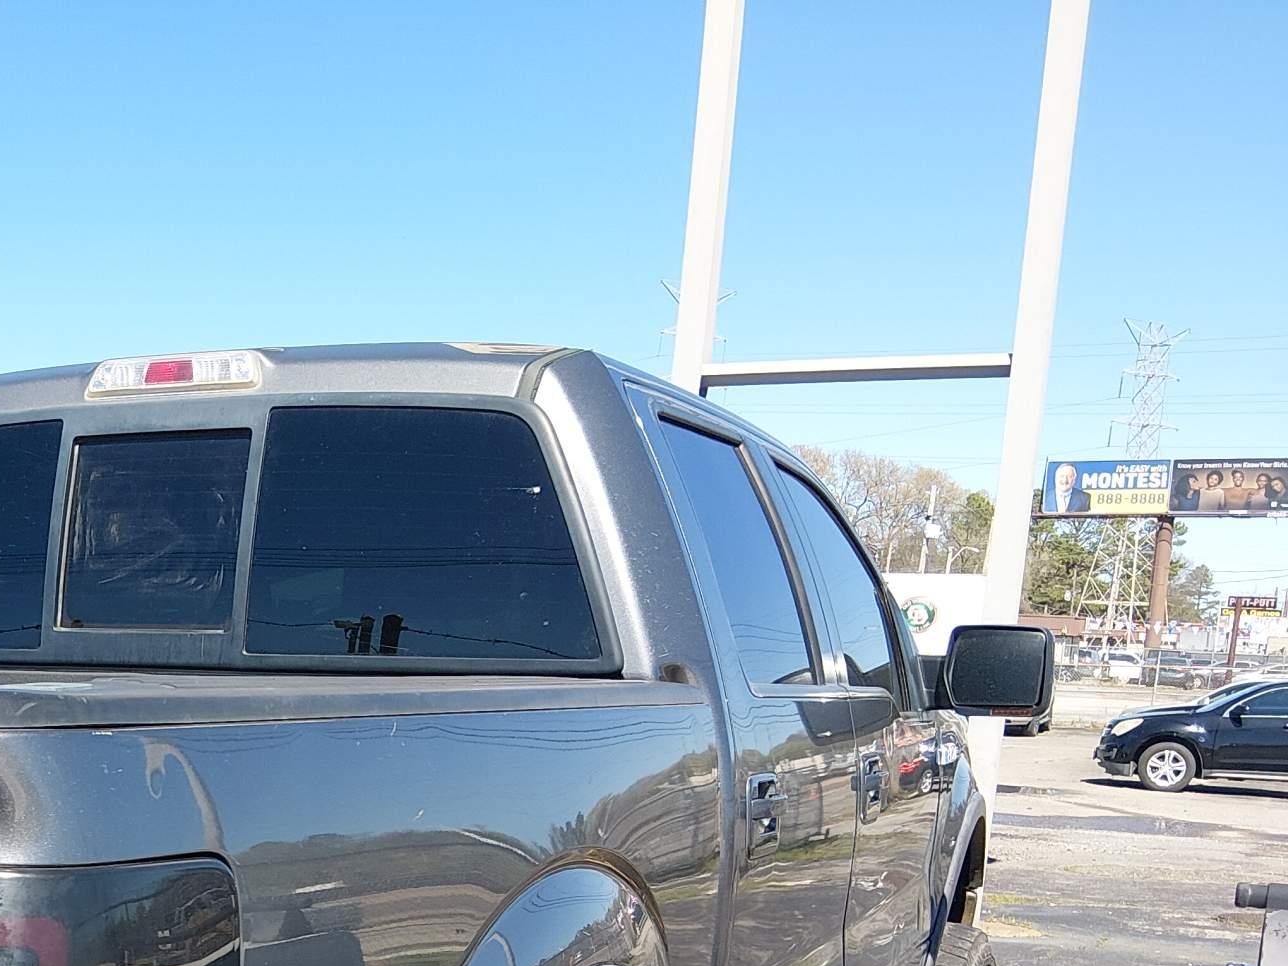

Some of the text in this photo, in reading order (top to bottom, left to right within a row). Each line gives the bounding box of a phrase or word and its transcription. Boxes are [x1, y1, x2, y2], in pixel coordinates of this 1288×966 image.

[1129, 464, 1151, 473] EASY
[1082, 472, 1168, 489] MONTESI
[1228, 598, 1276, 607] PTT-PUTT
